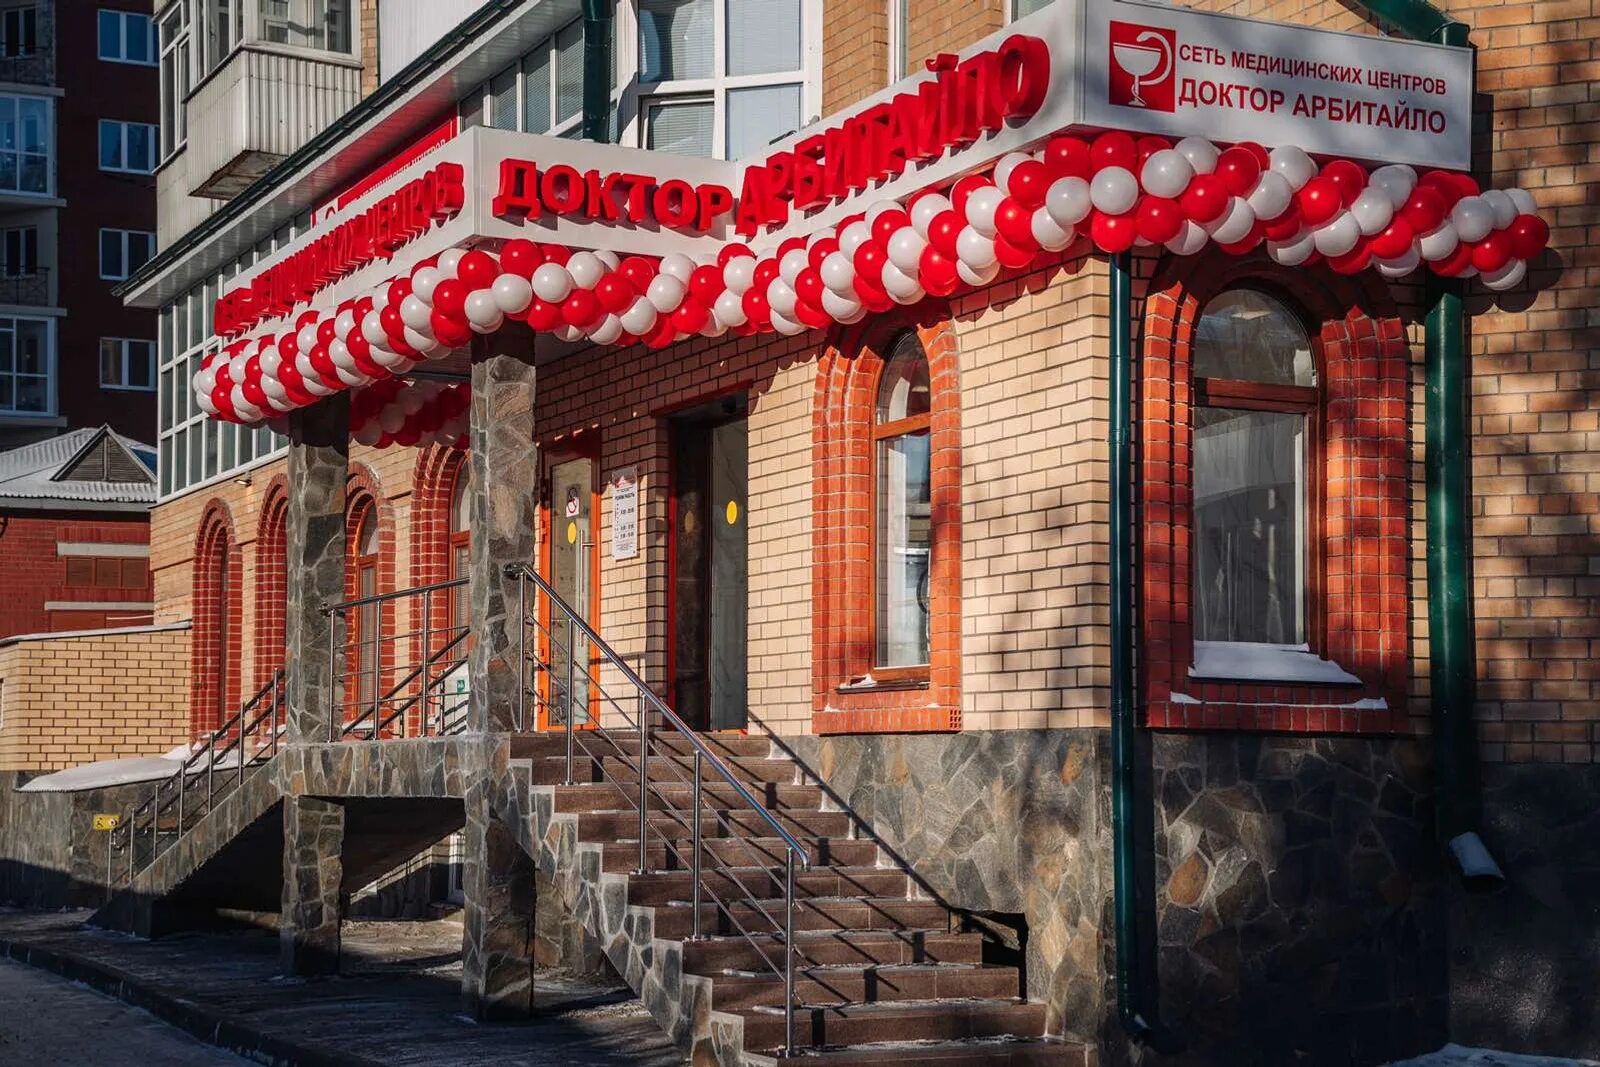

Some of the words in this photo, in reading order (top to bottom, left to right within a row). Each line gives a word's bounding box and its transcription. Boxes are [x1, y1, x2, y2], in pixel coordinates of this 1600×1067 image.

[1179, 43, 1226, 66] СЕТЬ
[1231, 51, 1363, 86] МЕДИЦИНСКИХ
[1367, 68, 1447, 96] ЦЕНТРОВ
[1178, 77, 1285, 113] ДОКТОР
[1292, 96, 1447, 134] АРБИТАЙЛО
[491, 157, 734, 233] ДОКТОР
[734, 33, 1051, 241] АРБИТАЙЛО
